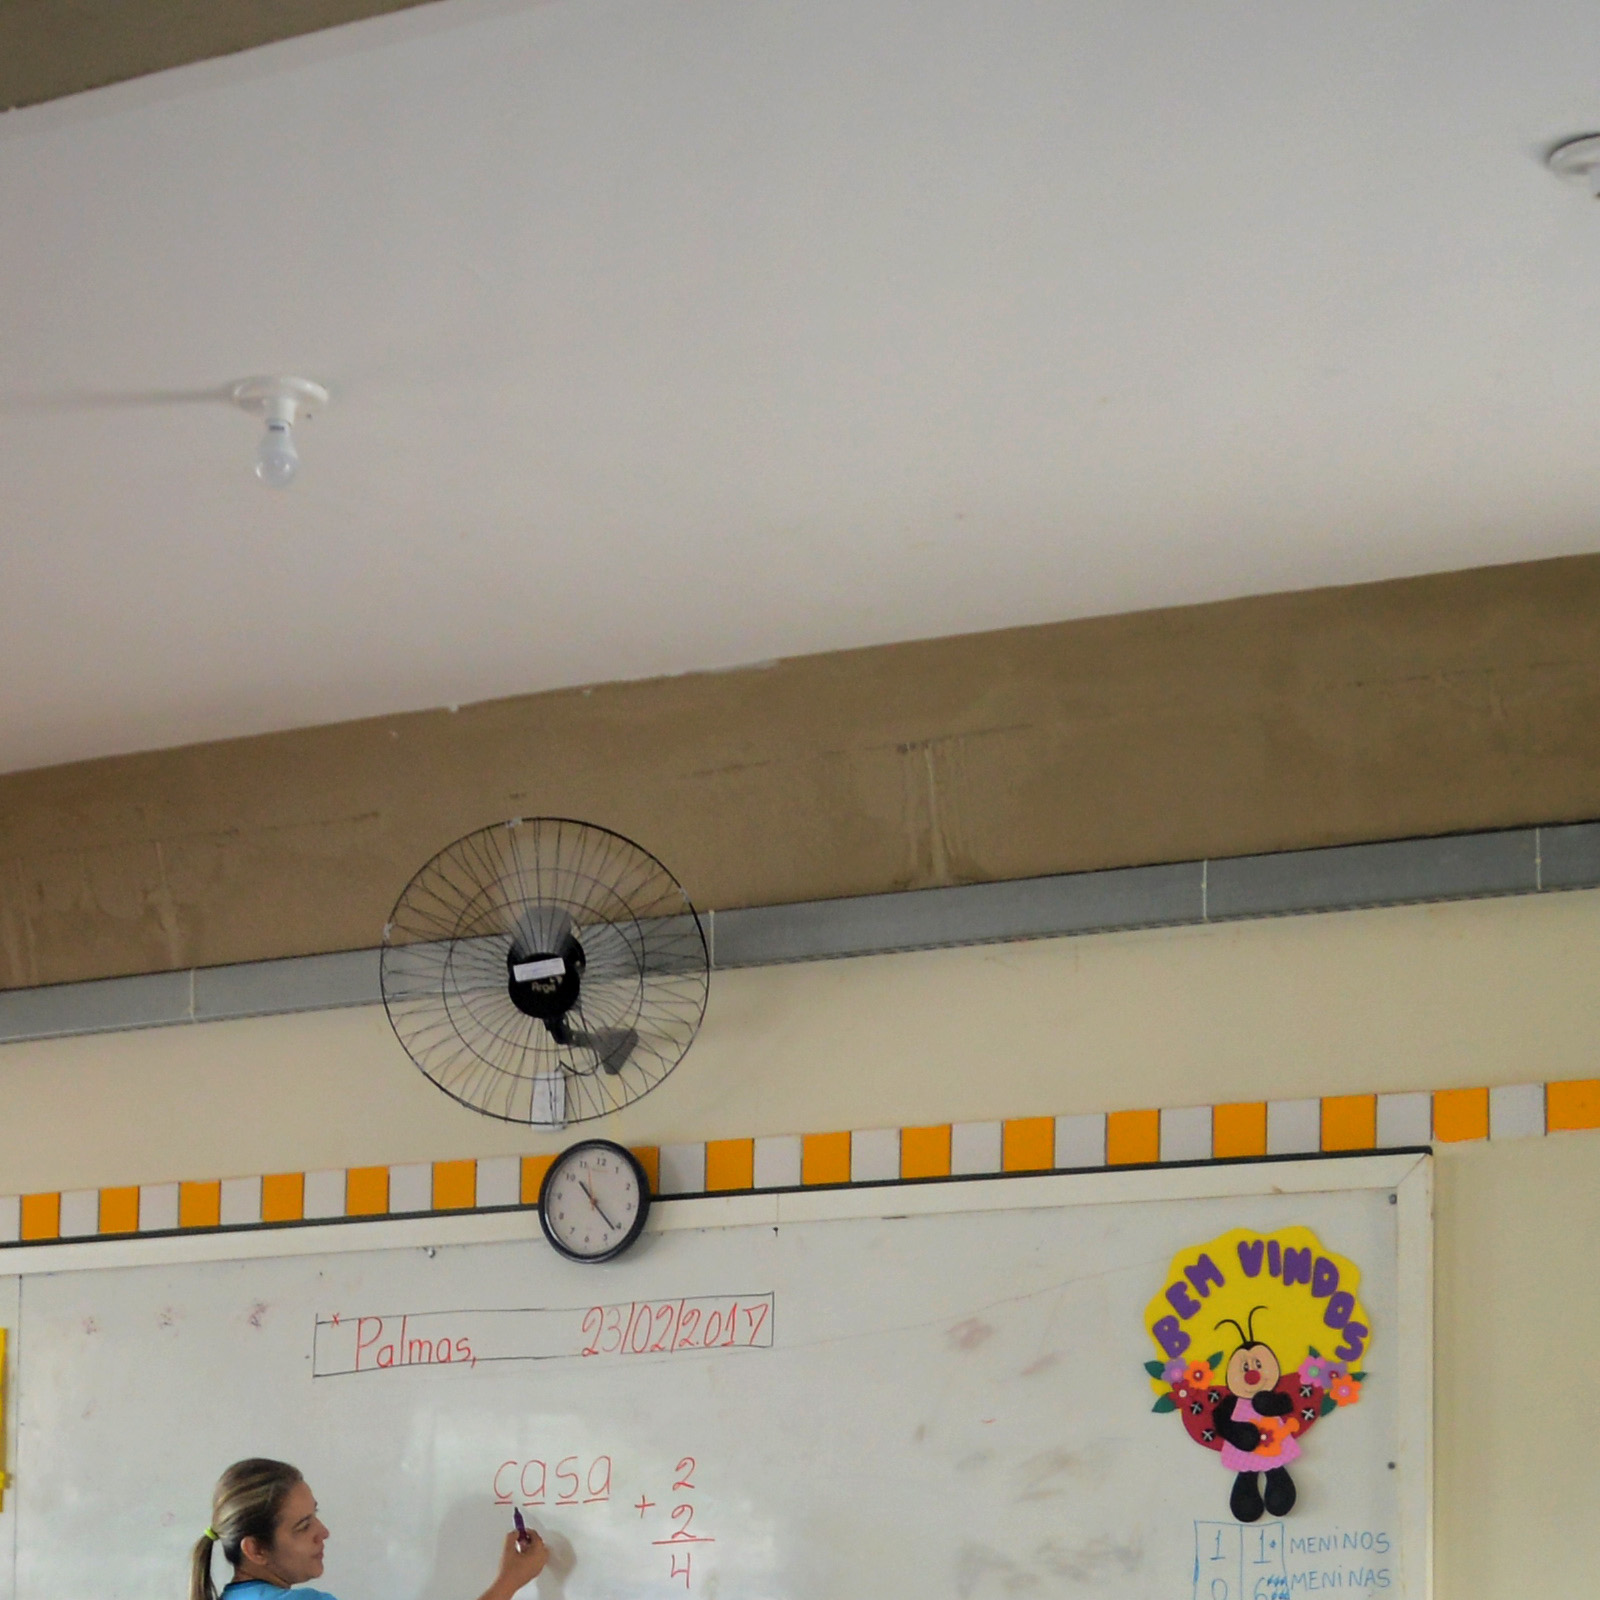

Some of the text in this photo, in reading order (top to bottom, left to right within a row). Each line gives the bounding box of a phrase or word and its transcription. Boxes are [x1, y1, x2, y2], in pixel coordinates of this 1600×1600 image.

[1152, 1239, 1369, 1362] BEM VINDOS
[356, 1314, 477, 1372] Palmas,
[493, 1455, 612, 1500] casa
[672, 1457, 695, 1491] 2
[671, 1504, 697, 1540] 2
[1210, 1529, 1226, 1561] 1
[671, 1552, 691, 1589] 4
